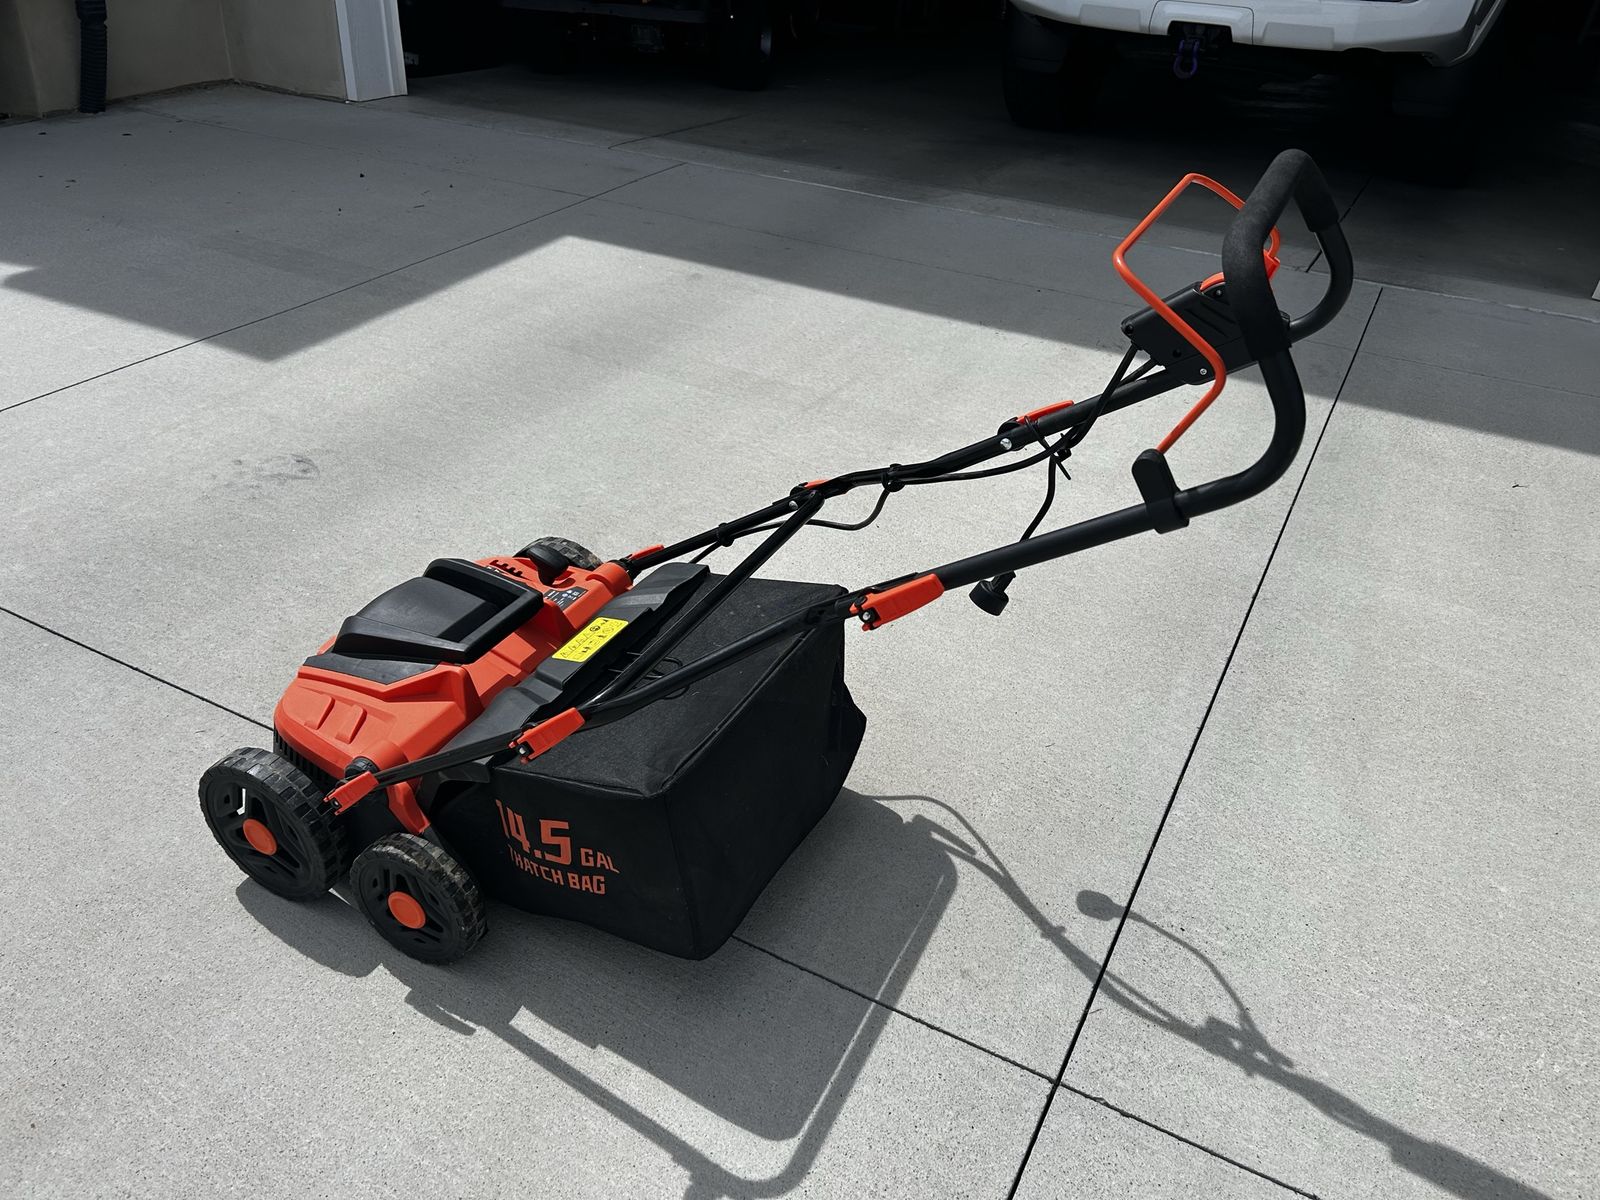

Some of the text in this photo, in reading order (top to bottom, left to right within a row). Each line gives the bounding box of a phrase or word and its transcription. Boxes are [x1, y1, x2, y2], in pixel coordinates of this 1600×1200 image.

[496, 799, 620, 874] 14.5 GAL
[508, 844, 606, 895] THATCH BAG
